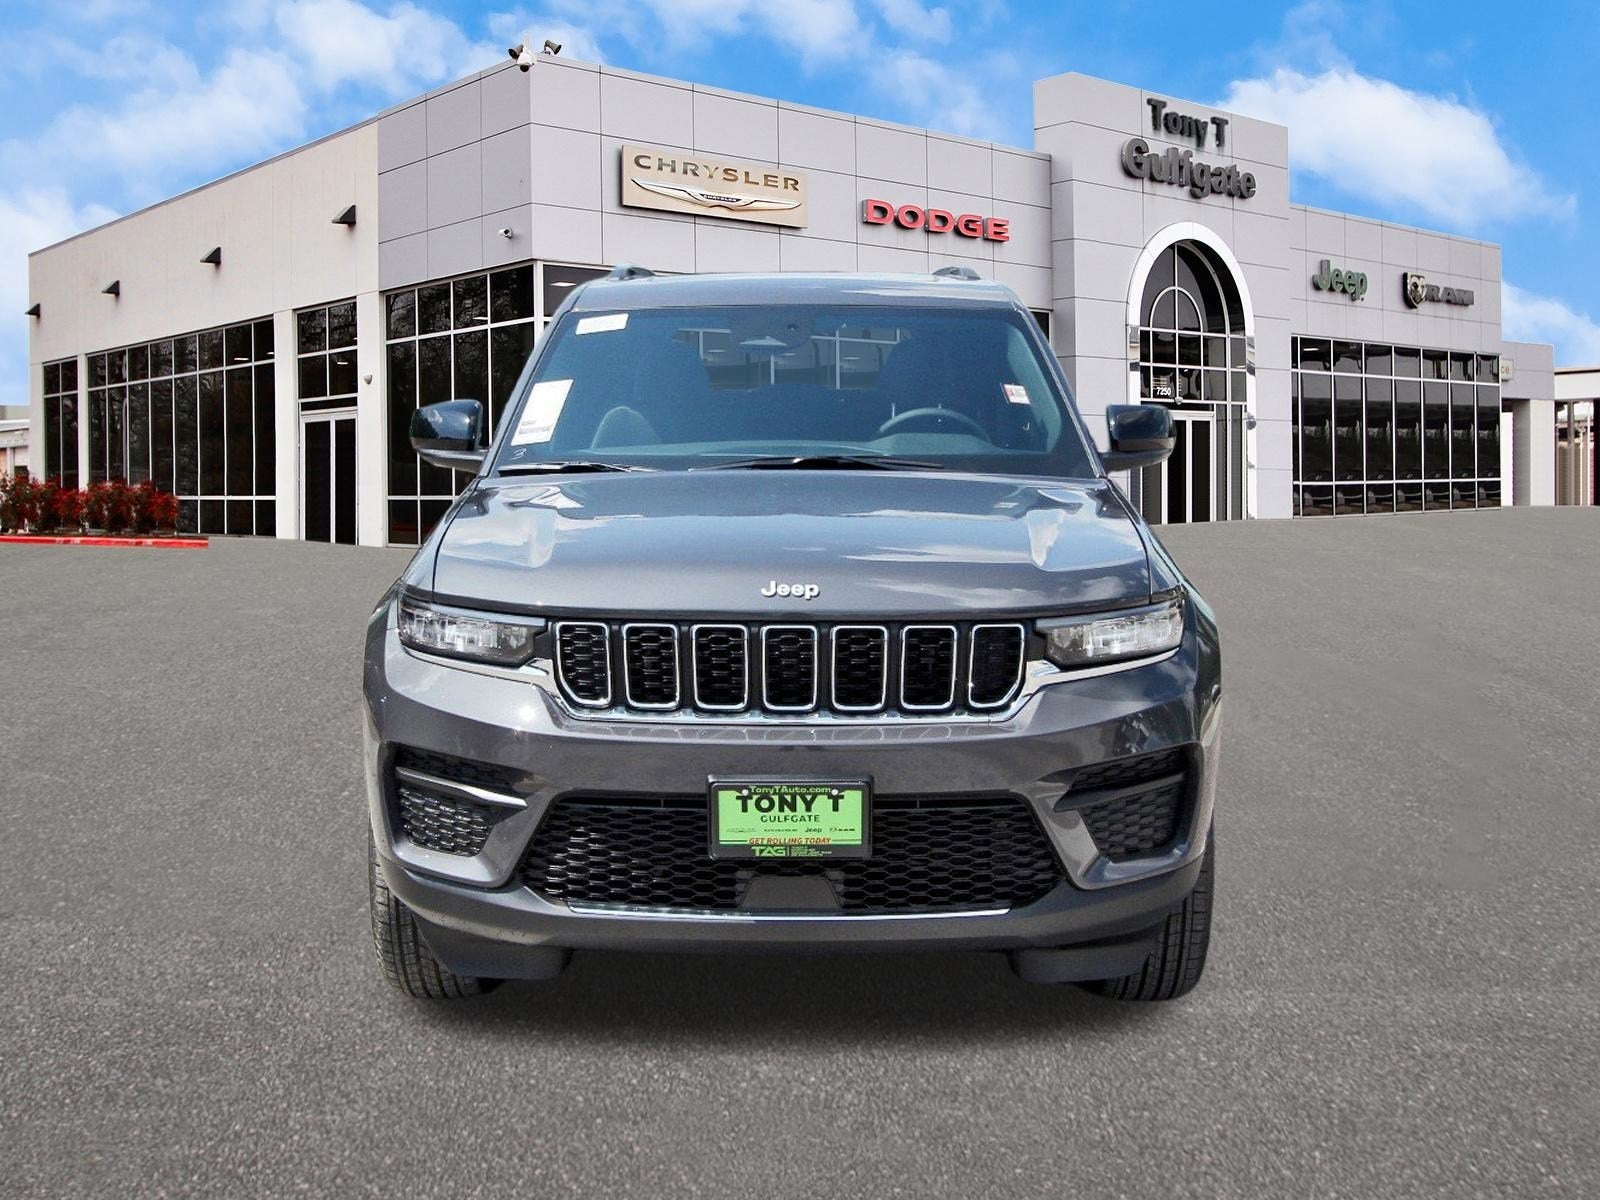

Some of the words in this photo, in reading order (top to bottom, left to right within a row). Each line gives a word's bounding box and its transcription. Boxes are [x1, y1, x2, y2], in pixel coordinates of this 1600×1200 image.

[1147, 98, 1208, 147] Tony
[1210, 116, 1229, 147] T
[633, 154, 800, 192] CHRYSLER
[1121, 138, 1256, 199] Gulfgate
[863, 198, 1010, 242] DODGE
[1312, 259, 1368, 302] Jeep
[1425, 284, 1475, 306] RAM
[1156, 387, 1171, 396] 7250
[761, 580, 820, 600] Jeep
[750, 785, 831, 795] TonyTAuto.com
[736, 793, 818, 813] TONY
[827, 793, 844, 812] T
[760, 814, 820, 823] GULFGATE
[749, 837, 766, 845] GET
[767, 837, 802, 845] ROLLING
[804, 837, 832, 845] TODAY
[751, 846, 786, 857] TAG
